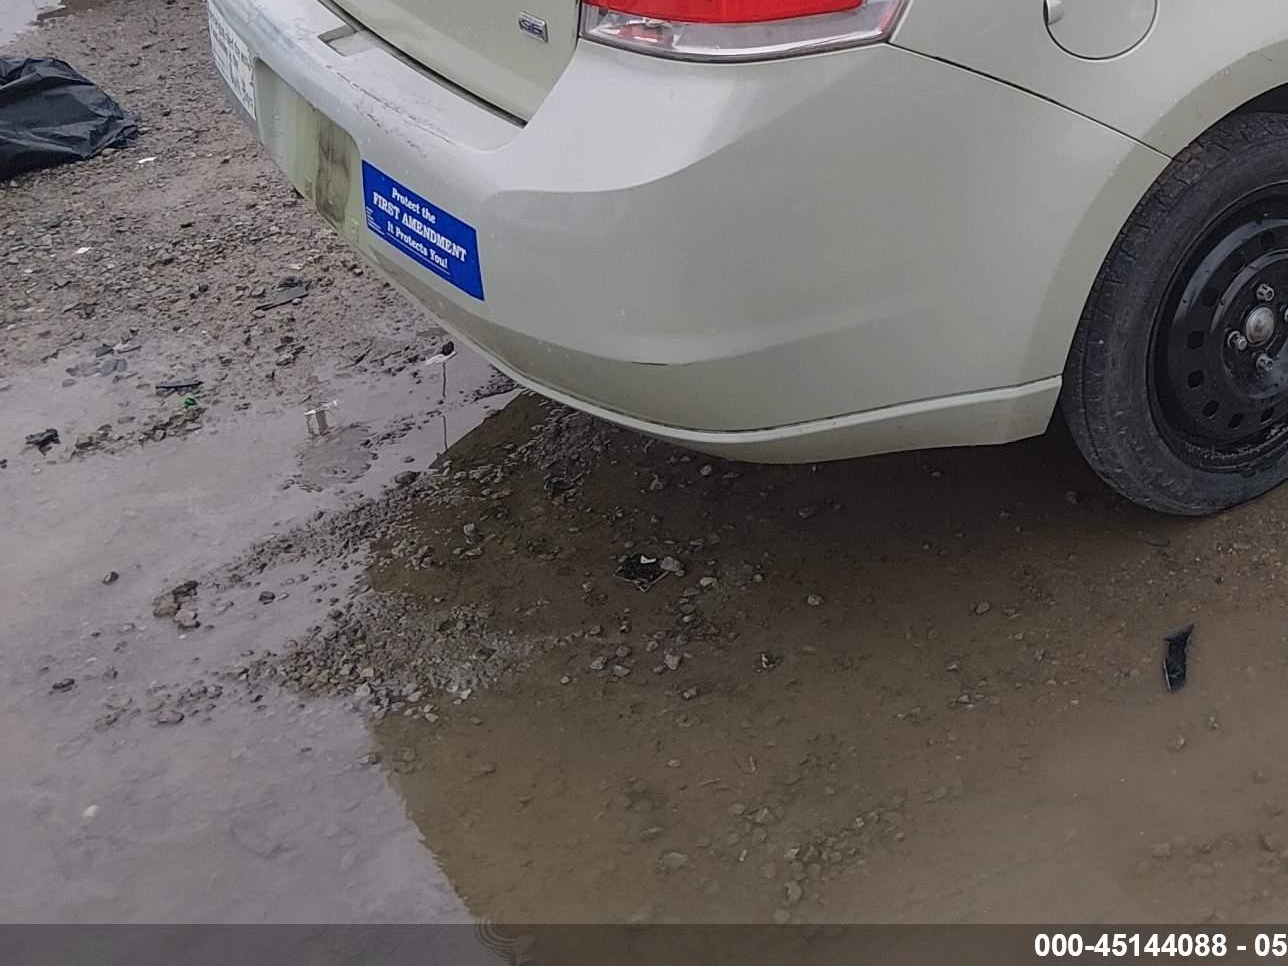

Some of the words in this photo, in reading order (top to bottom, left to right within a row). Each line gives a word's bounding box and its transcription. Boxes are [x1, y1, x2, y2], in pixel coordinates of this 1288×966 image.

[391, 187, 420, 215] Protect
[421, 208, 436, 224] the
[372, 191, 401, 220] FIRST
[401, 213, 467, 263] AMENDMENT
[395, 227, 428, 257] Protects
[429, 248, 449, 269] You!
